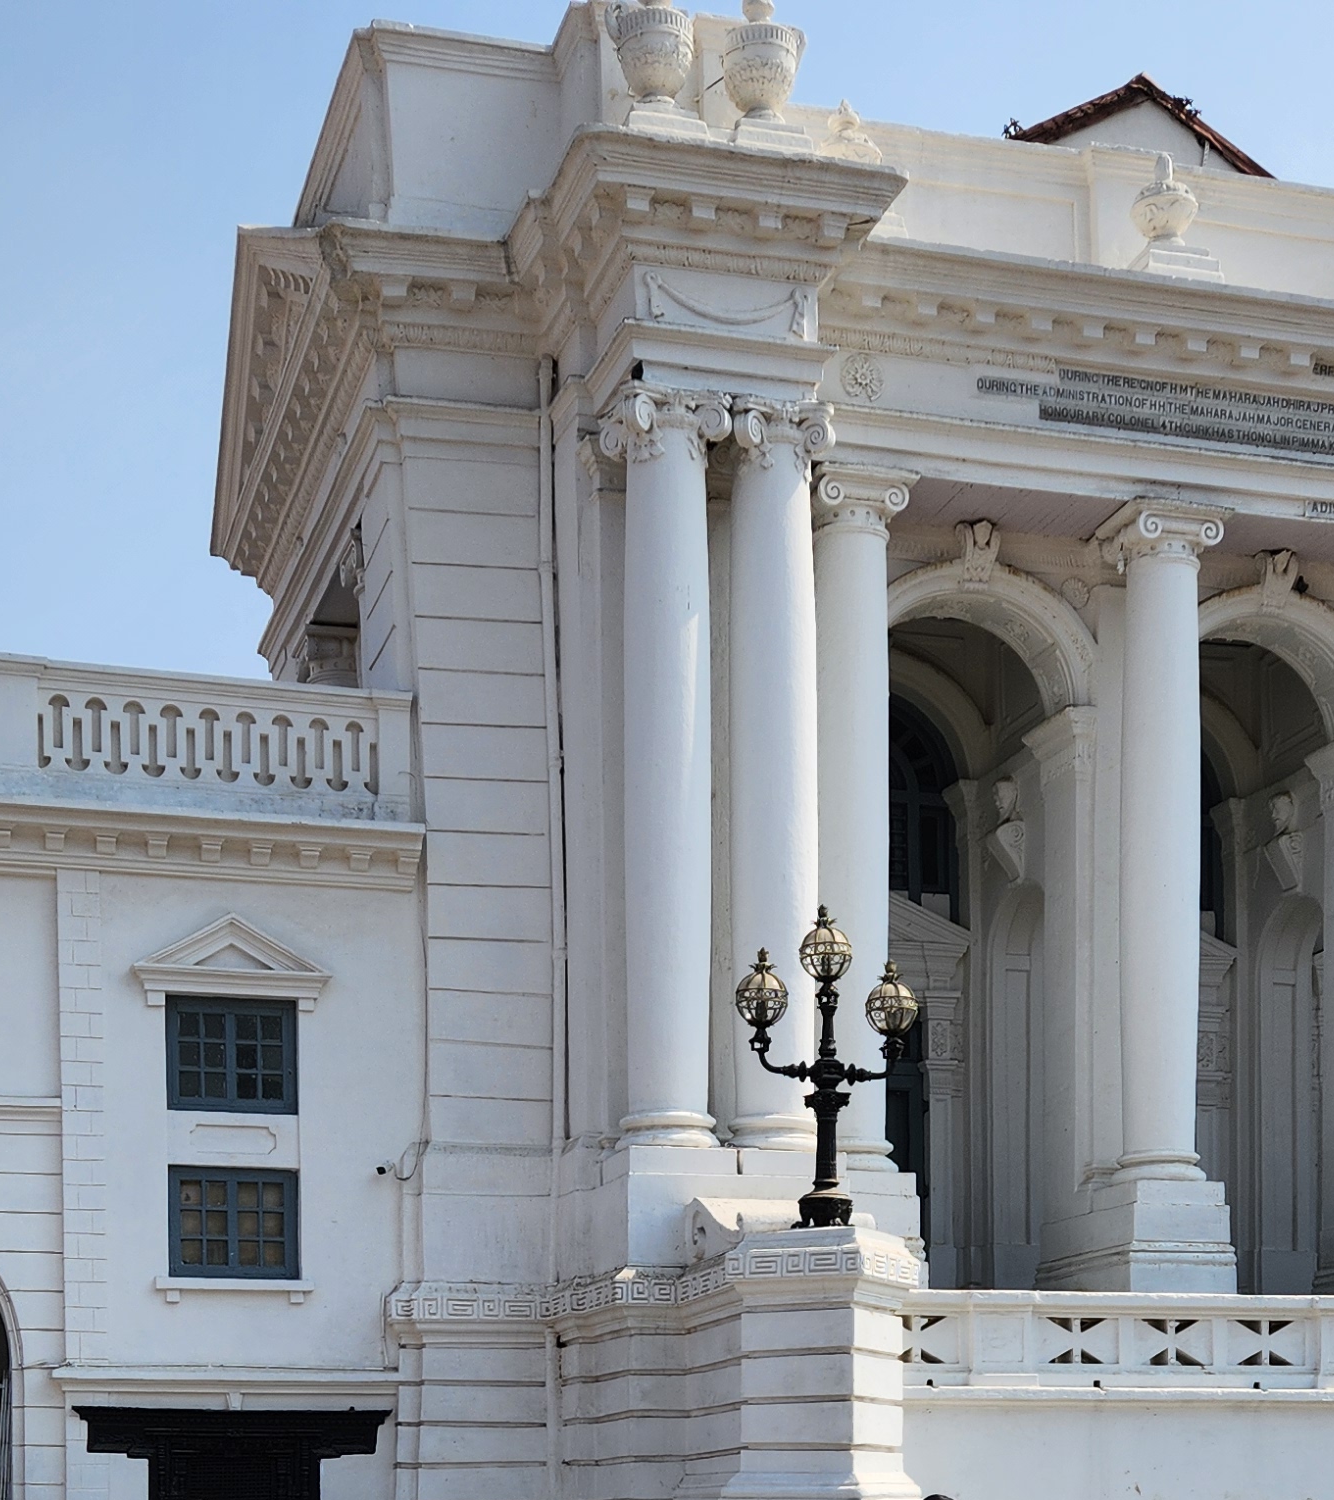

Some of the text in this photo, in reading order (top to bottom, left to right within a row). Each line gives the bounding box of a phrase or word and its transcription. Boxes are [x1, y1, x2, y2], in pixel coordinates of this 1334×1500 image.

[976, 377, 1017, 393] DURING
[1018, 382, 1040, 396] THE
[1041, 385, 1133, 407] ADMINISTRATION
[1133, 396, 1149, 410] OF
[1167, 401, 1188, 415] THE
[1189, 405, 1256, 424] MAHARAJAH
[1256, 412, 1293, 428] MAJOR
[1058, 368, 1098, 384] DURING
[1100, 374, 1122, 387] THE
[1154, 381, 1167, 393] OF
[1189, 385, 1211, 399] THE
[1212, 388, 1280, 408] MAHARAJAH
[1038, 403, 1107, 423] HONOURARY
[1107, 412, 1158, 430] COLONEL
[1183, 422, 1234, 439] GURKHAS
[1235, 429, 1273, 445] THONG
[1273, 434, 1291, 446] LIN
[1291, 435, 1328, 451] PIMMA
